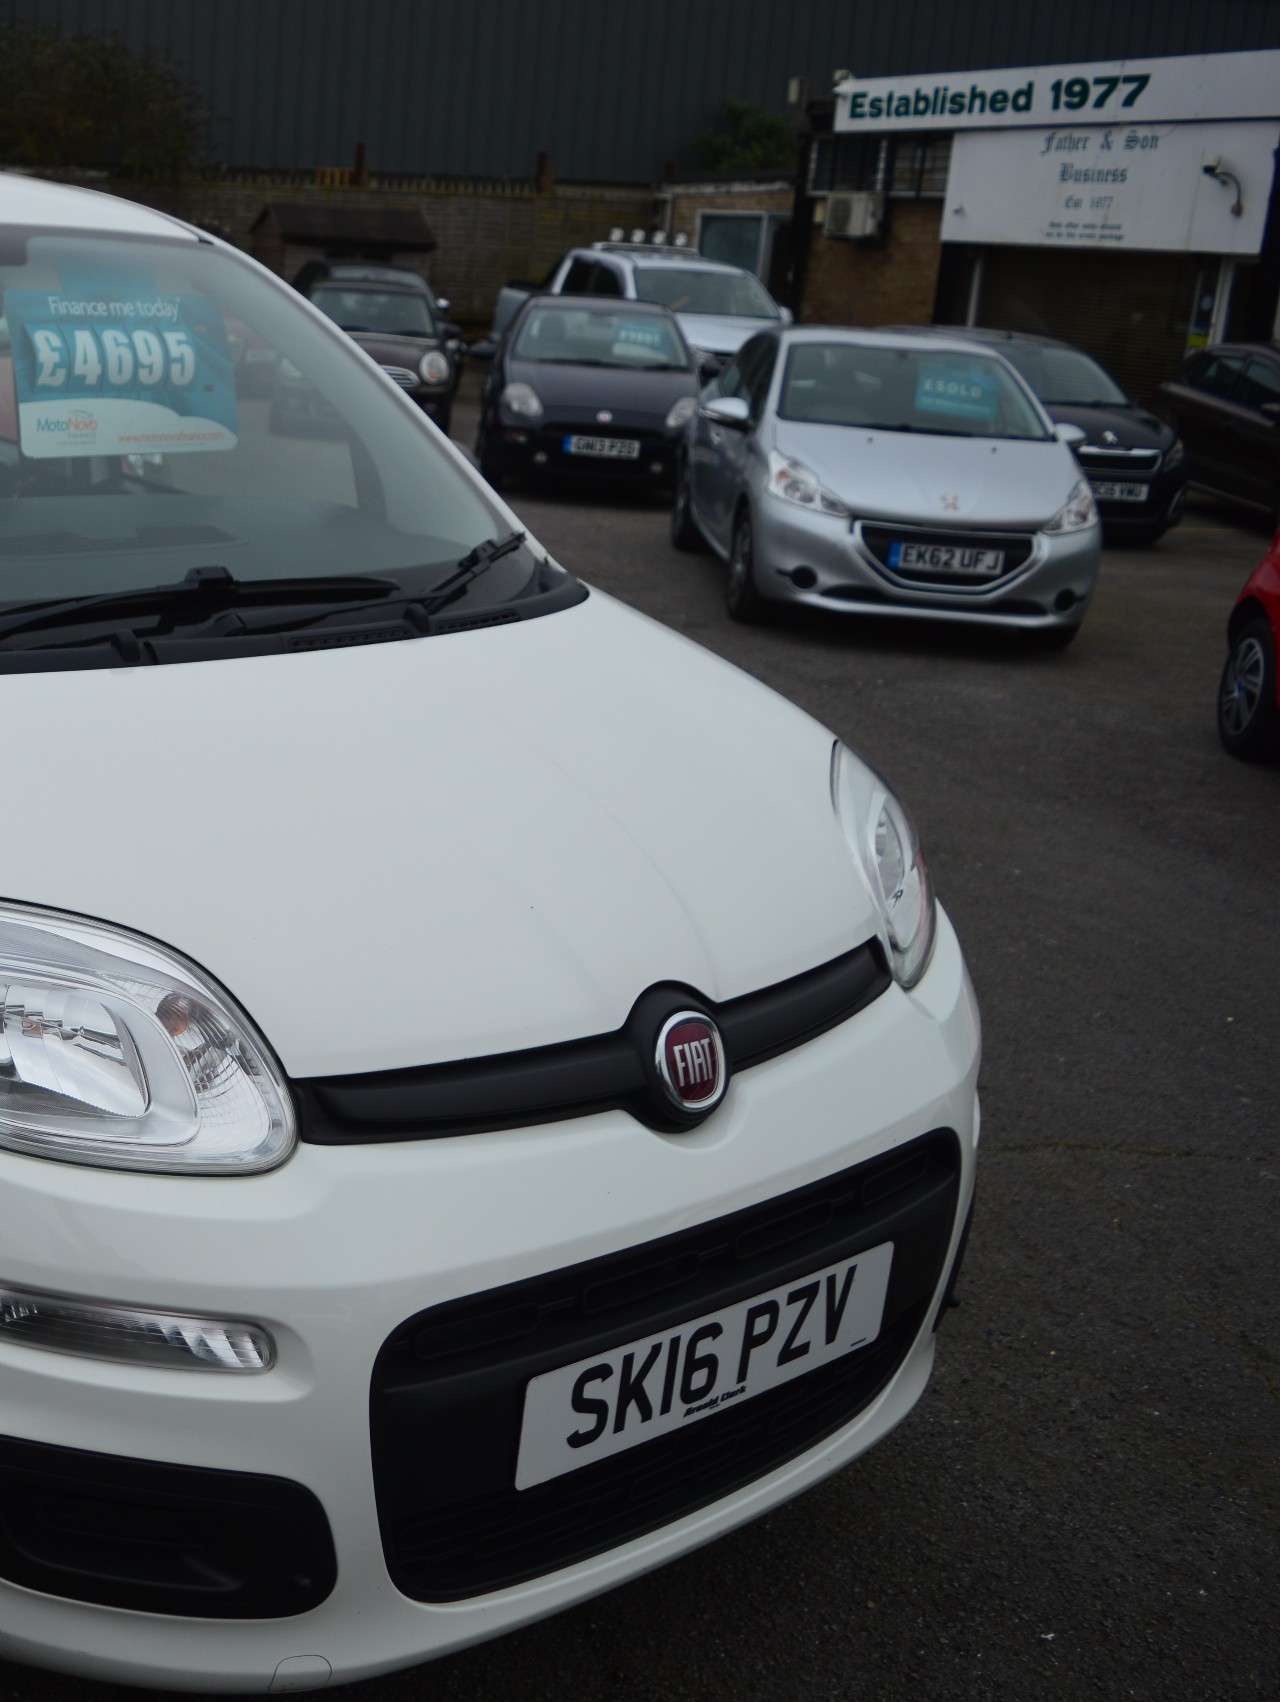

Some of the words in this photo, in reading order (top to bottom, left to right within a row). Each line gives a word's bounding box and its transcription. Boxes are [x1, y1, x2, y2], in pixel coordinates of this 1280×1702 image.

[849, 80, 1034, 119] Established
[1050, 74, 1150, 111] 1977
[1040, 131, 1090, 156] Father
[1100, 129, 1113, 151] &
[1123, 129, 1160, 151] Son
[1060, 161, 1128, 183] Business
[48, 296, 109, 316] Finance
[110, 301, 134, 316] me
[33, 329, 195, 387] £4695
[901, 545, 956, 569] EK62
[960, 549, 1000, 571] UFJ
[673, 1038, 713, 1087] FIAT
[566, 1322, 723, 1449] SK16
[736, 1264, 857, 1385] PZV
